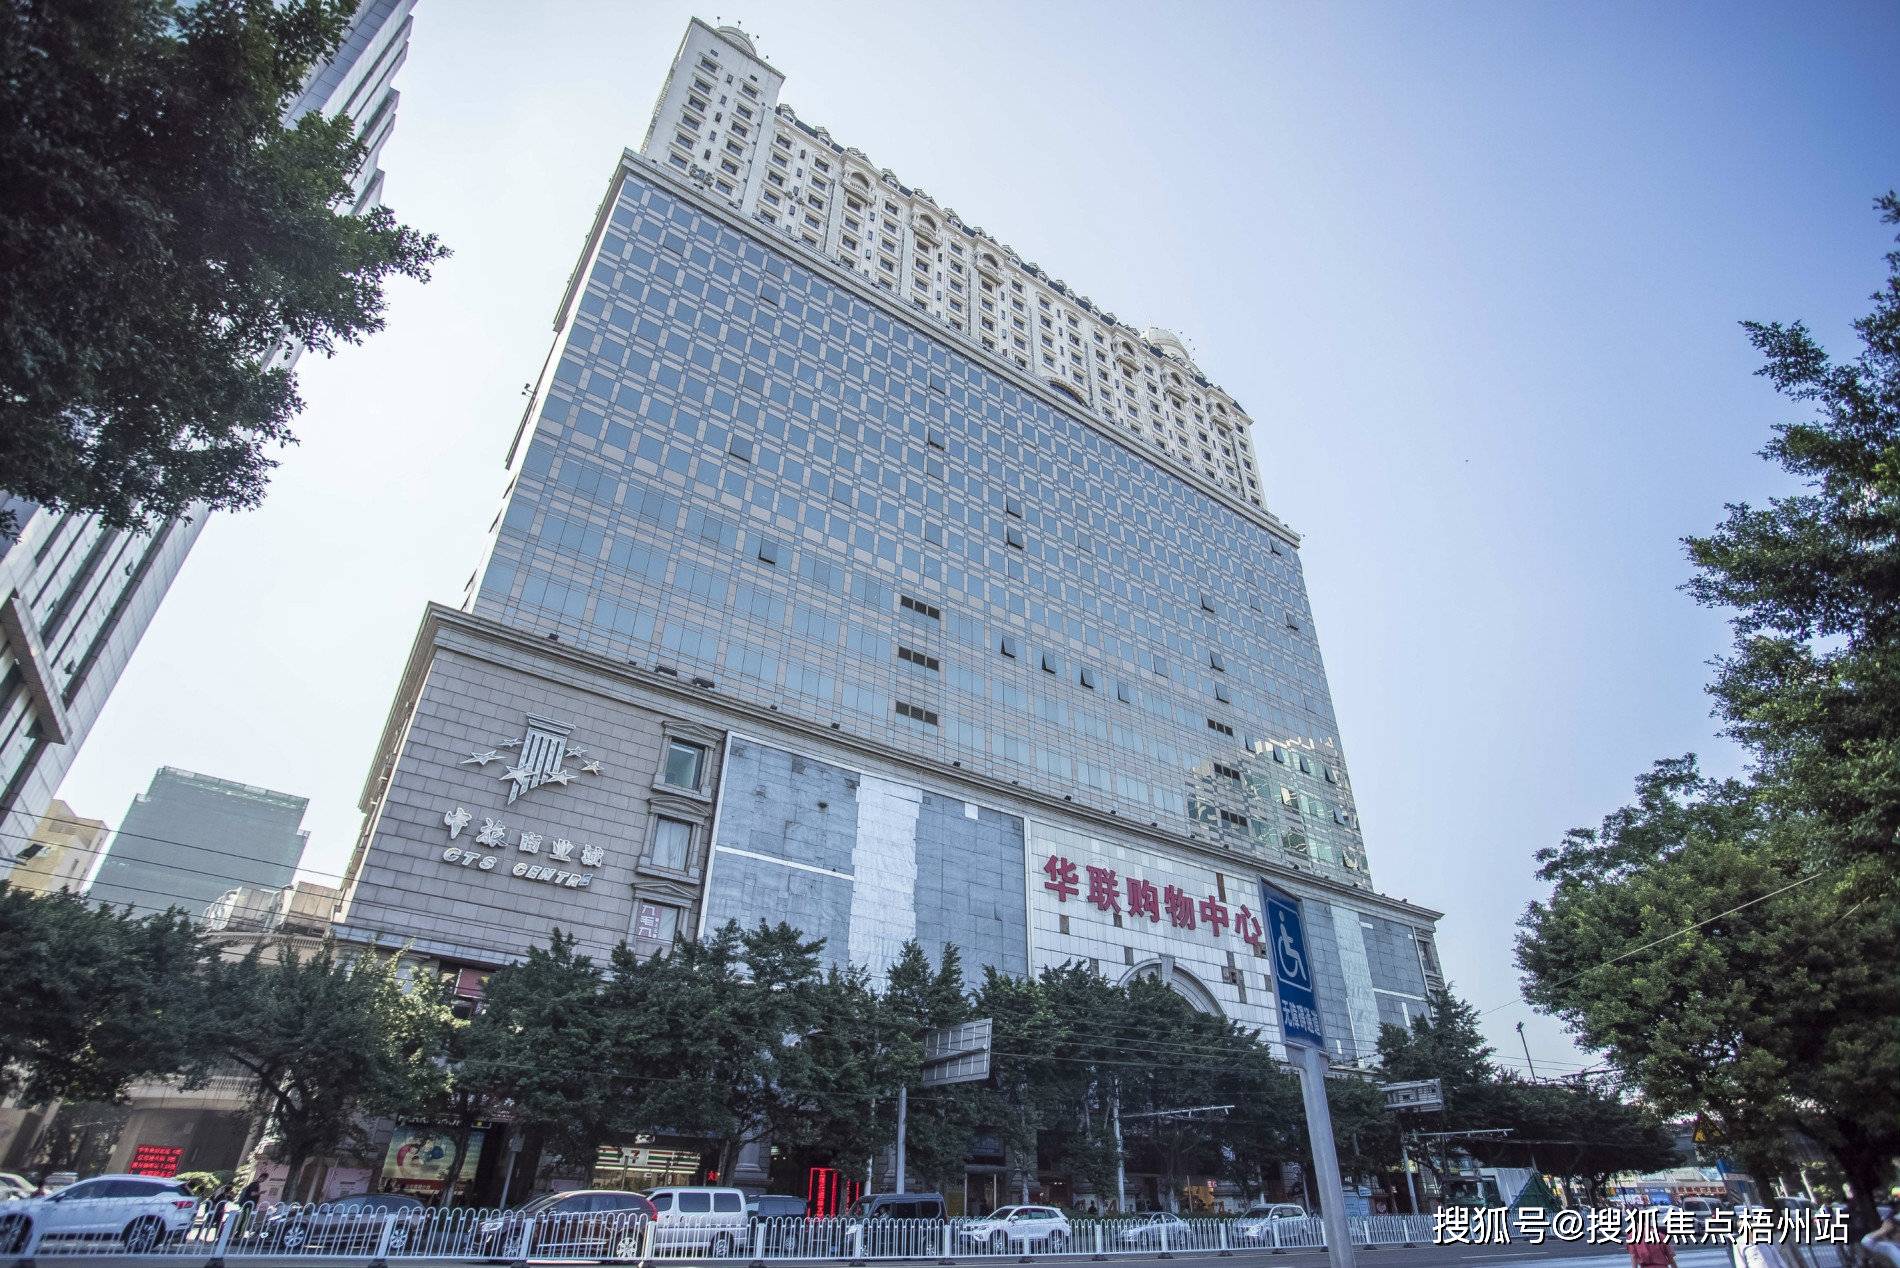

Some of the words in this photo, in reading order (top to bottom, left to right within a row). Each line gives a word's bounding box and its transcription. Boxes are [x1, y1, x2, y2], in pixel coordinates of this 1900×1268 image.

[443, 847, 497, 870] CTS
[1044, 855, 1263, 946] 华联购物中心
